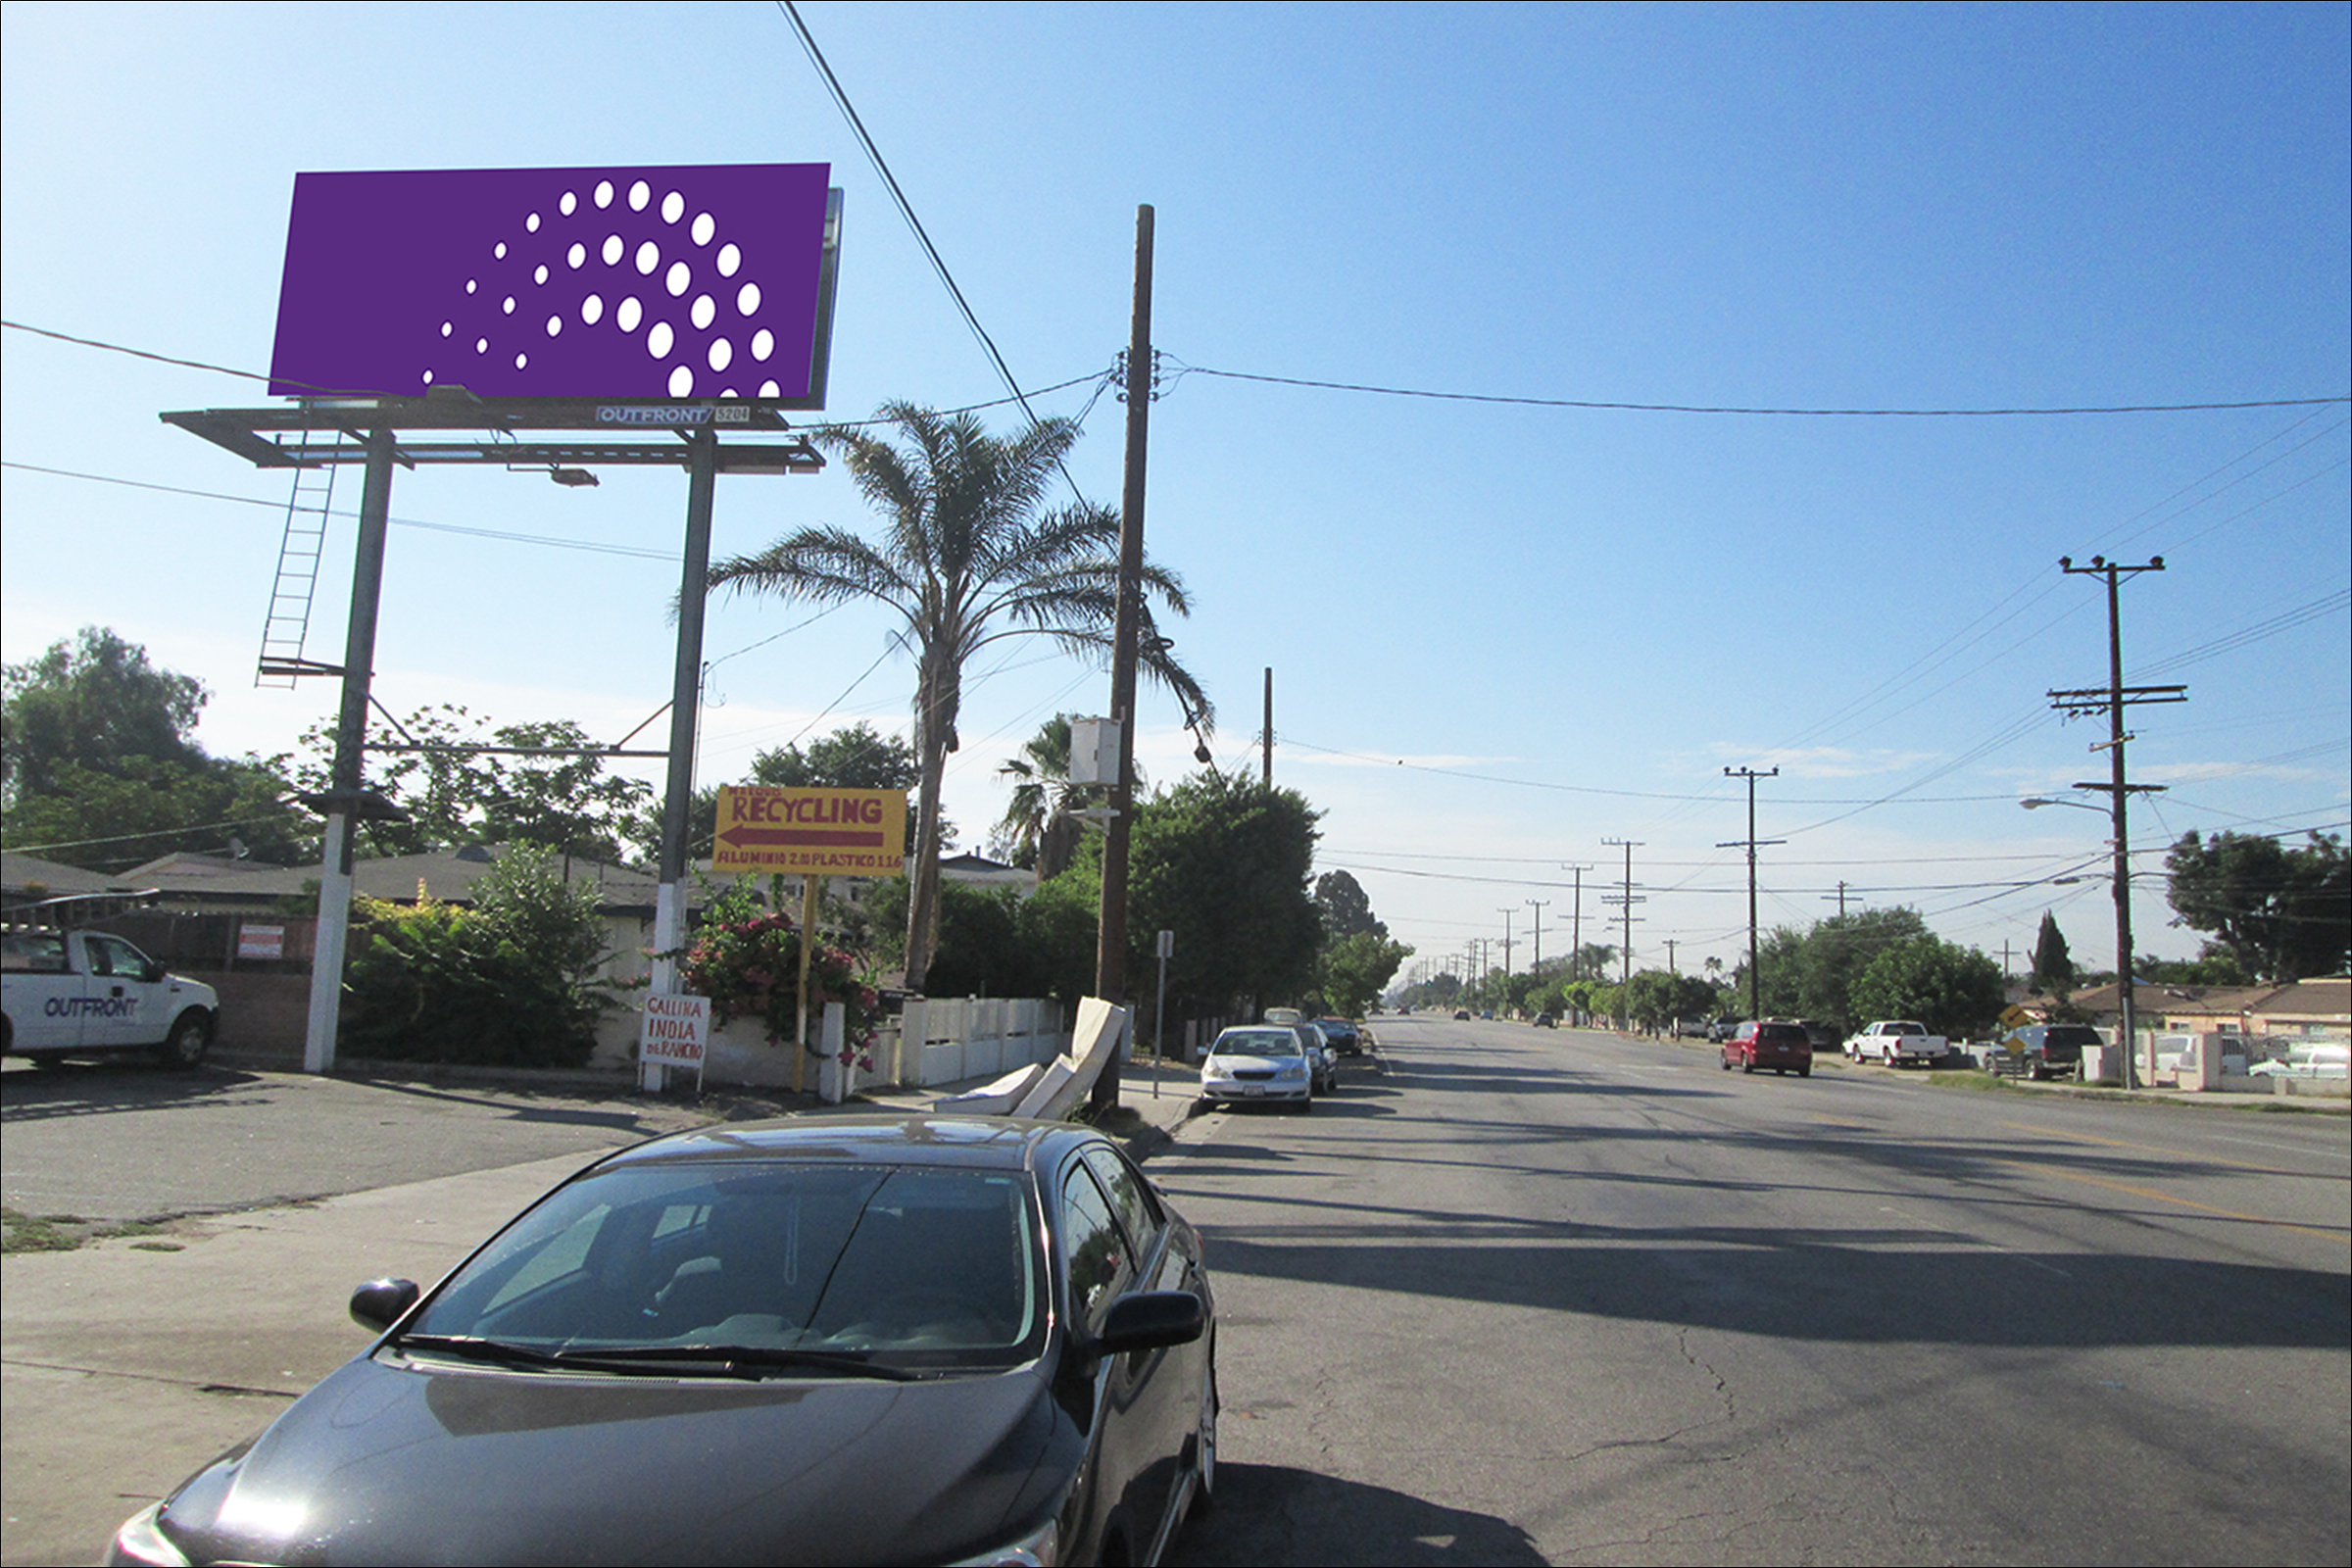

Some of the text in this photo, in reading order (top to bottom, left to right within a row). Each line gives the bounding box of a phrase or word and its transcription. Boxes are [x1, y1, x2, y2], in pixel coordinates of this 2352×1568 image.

[601, 408, 707, 422] OUTFRONT
[732, 798, 883, 824] RECYCLING
[717, 852, 785, 864] ALUMINIO
[812, 854, 875, 867] PLASTICO
[45, 998, 137, 1017] OUTFRONT
[649, 1018, 695, 1041] INDIA
[647, 1041, 703, 1059] DE RANCHO
